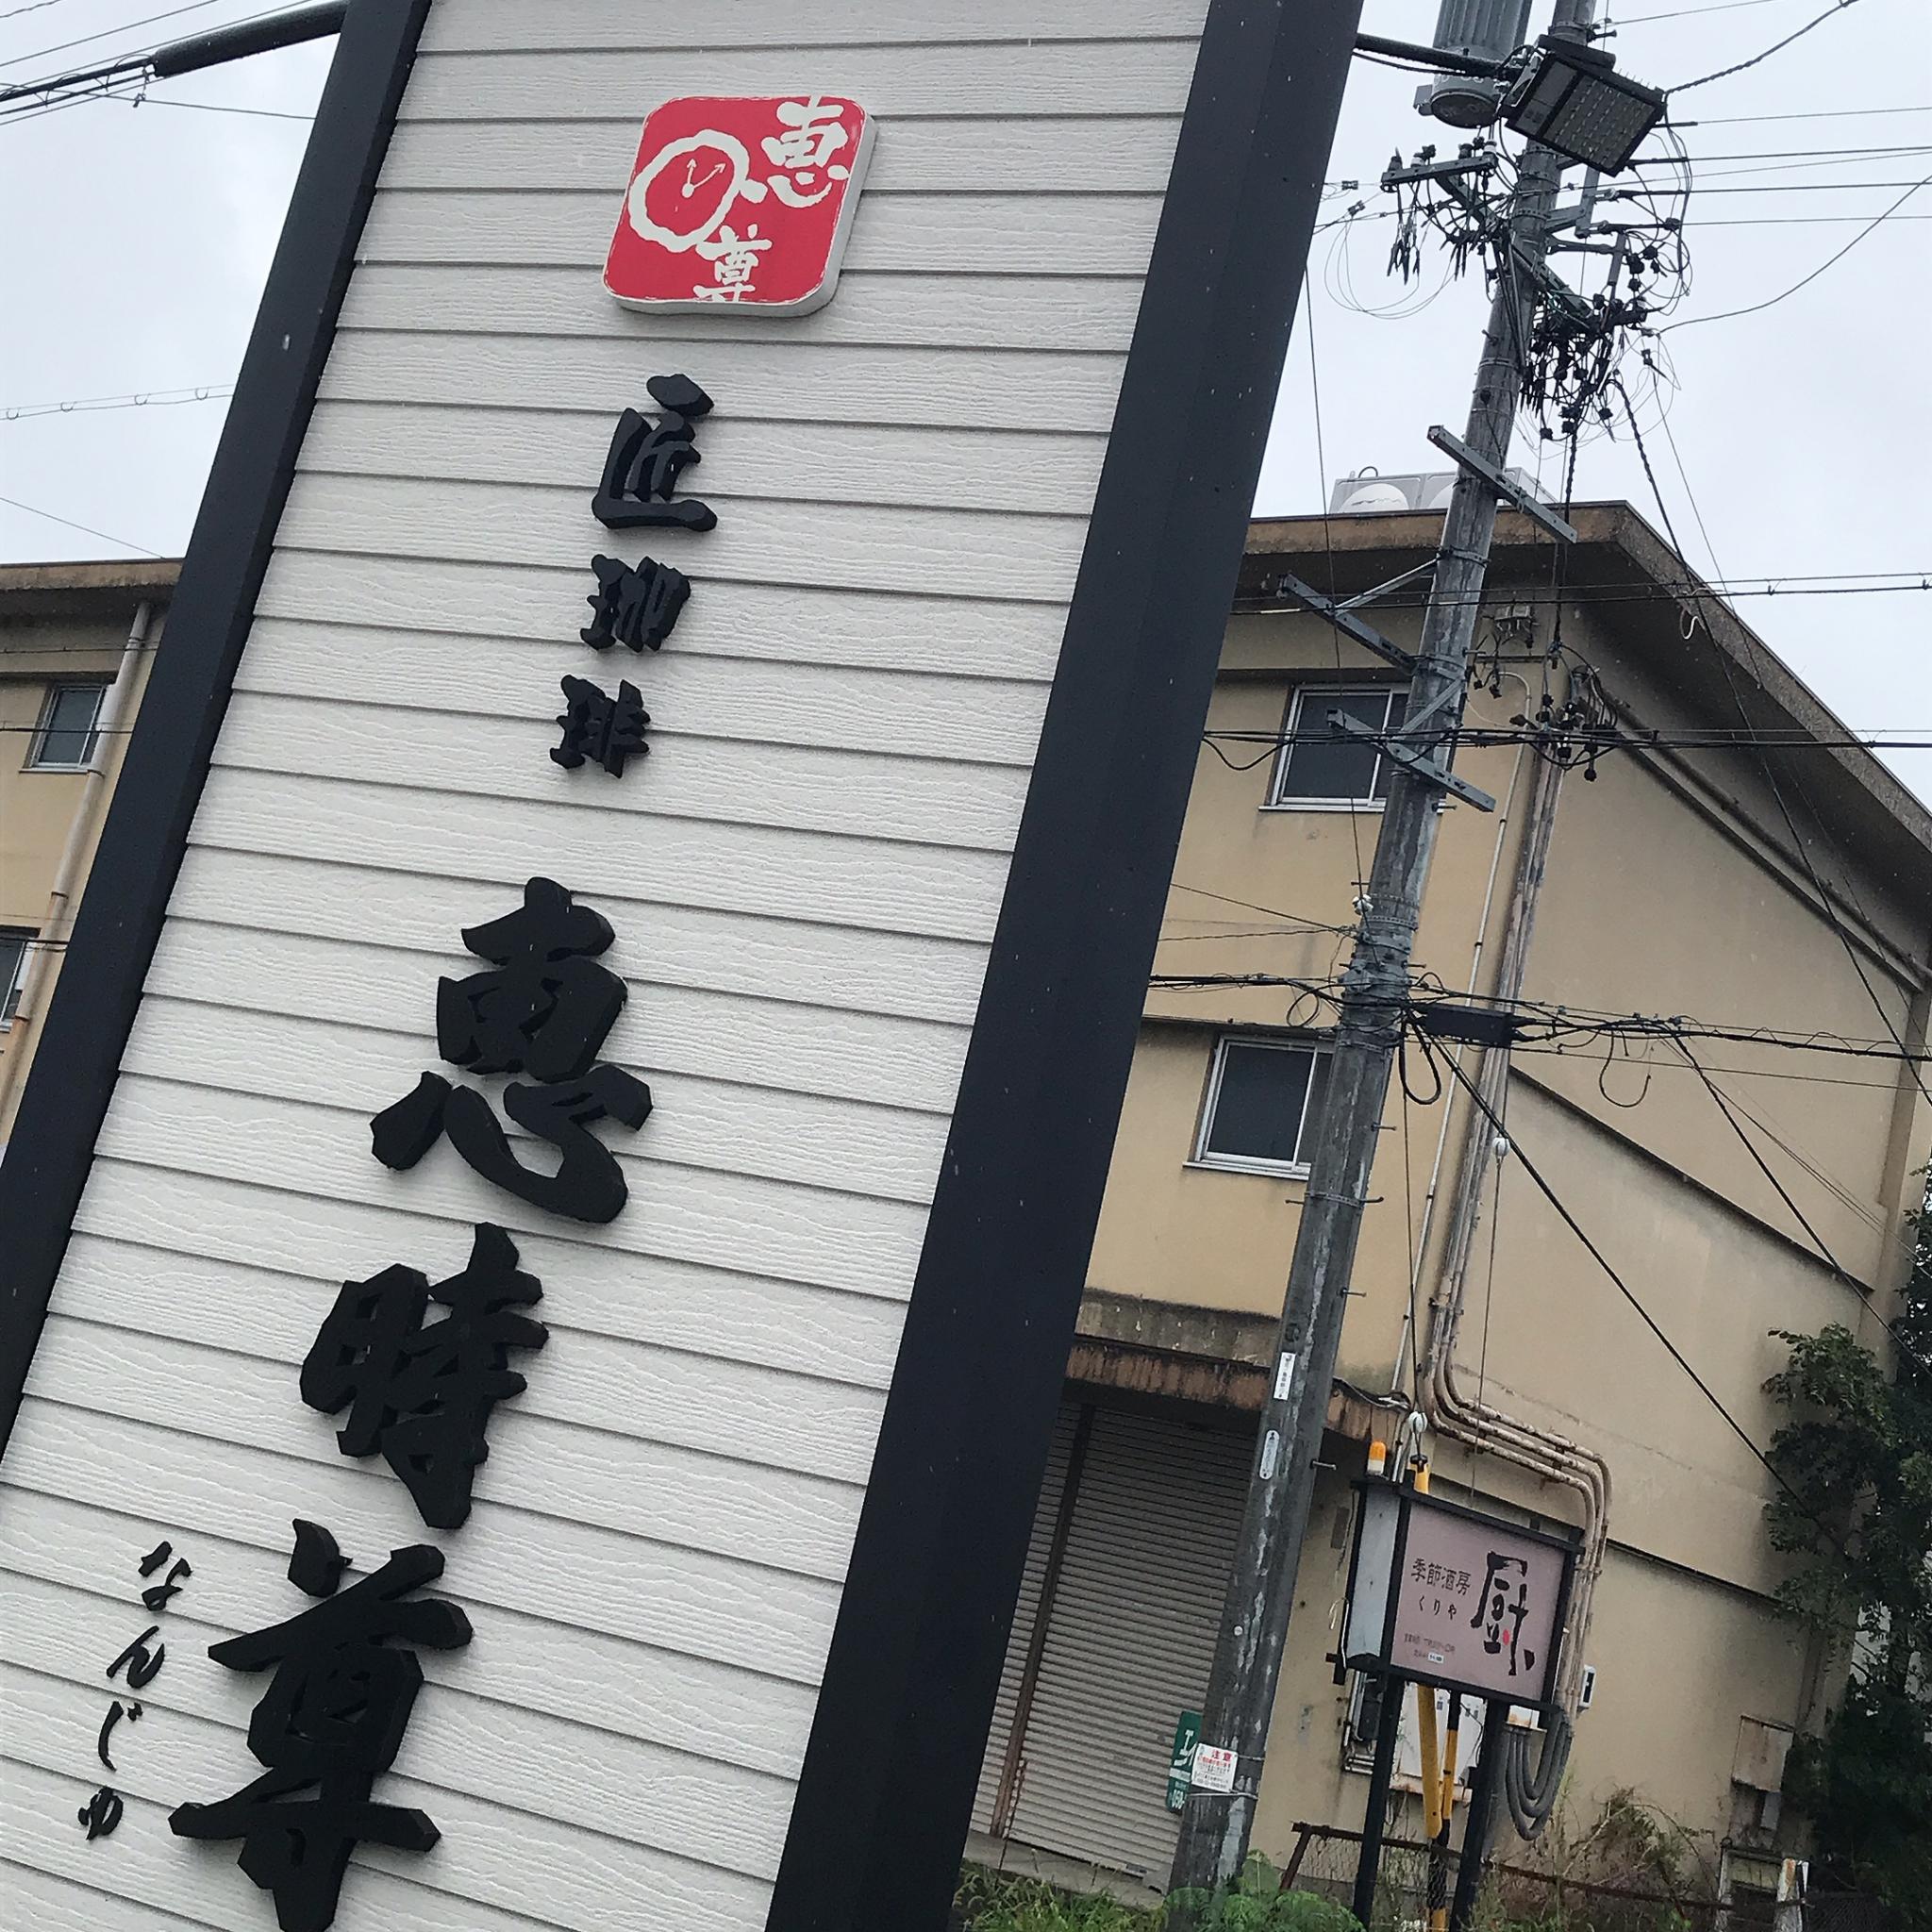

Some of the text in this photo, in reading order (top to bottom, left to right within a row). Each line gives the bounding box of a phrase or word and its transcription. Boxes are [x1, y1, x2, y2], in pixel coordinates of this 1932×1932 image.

[760, 96, 850, 208] 恵
[170, 877, 652, 1932] 恵時尊
[1411, 1558, 1471, 1596] 季節酒房
[1418, 1596, 1457, 1620] くりや
[1471, 1550, 1536, 1676] 厨
